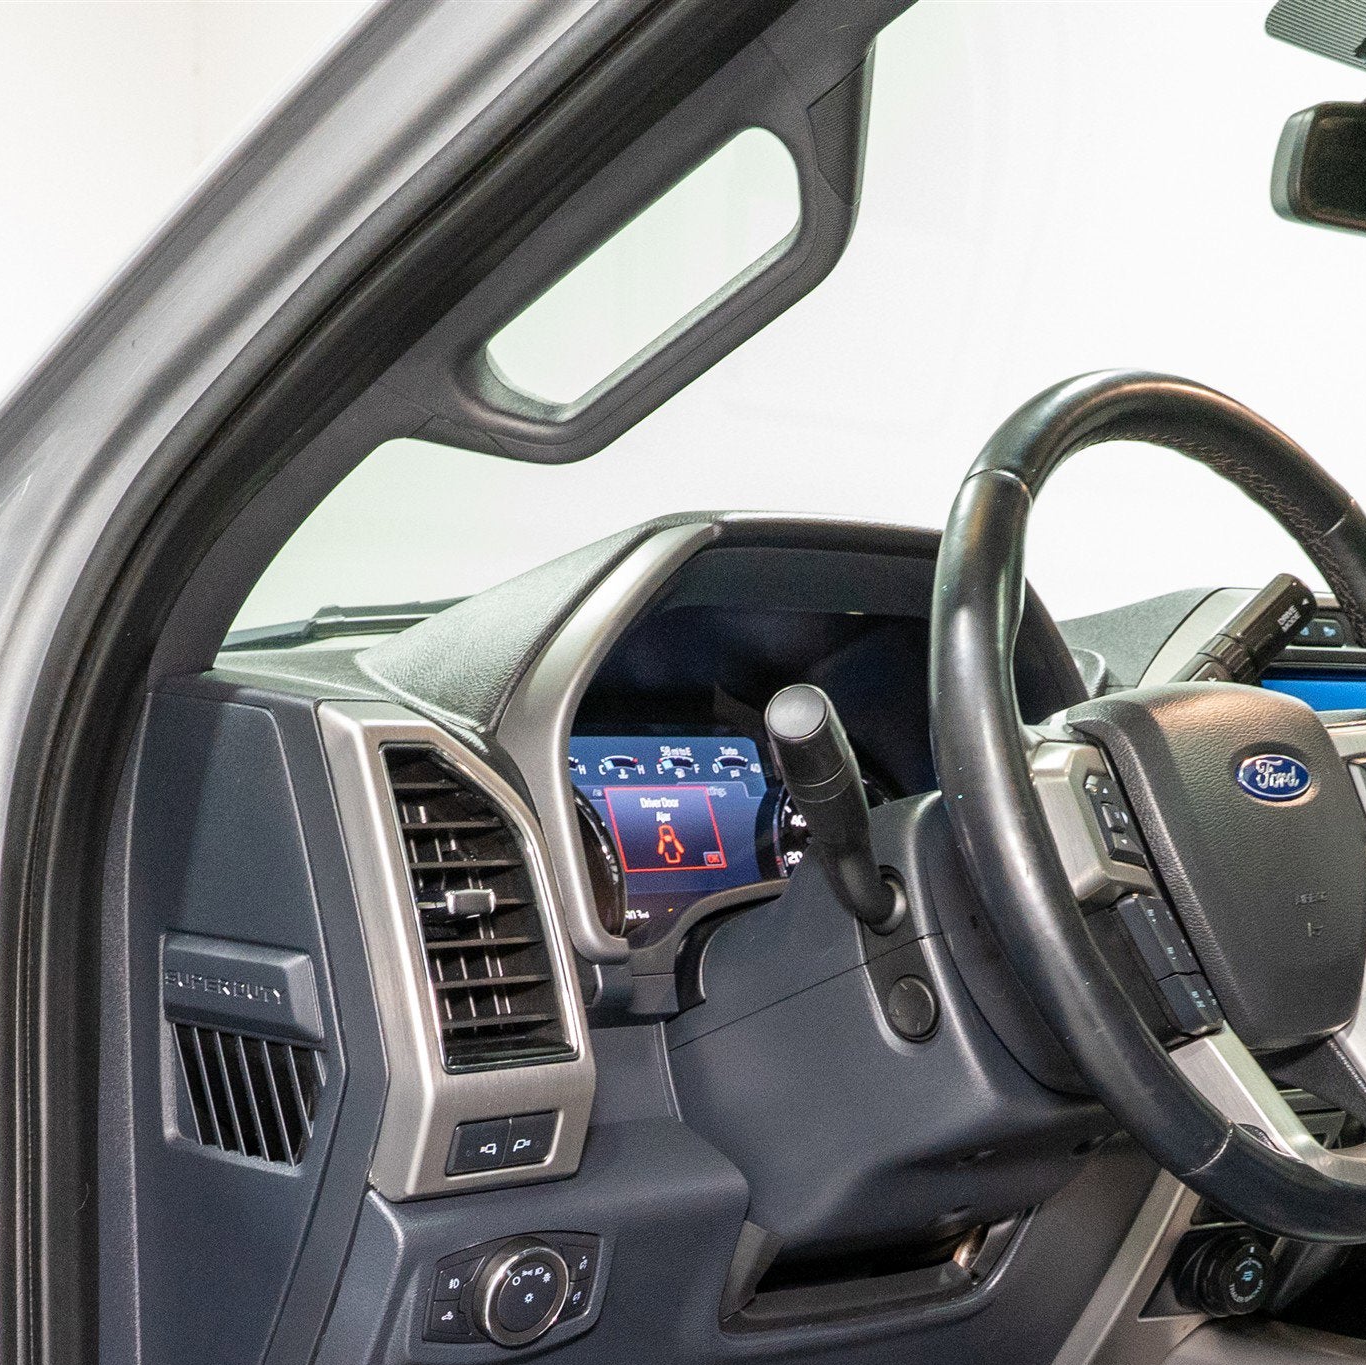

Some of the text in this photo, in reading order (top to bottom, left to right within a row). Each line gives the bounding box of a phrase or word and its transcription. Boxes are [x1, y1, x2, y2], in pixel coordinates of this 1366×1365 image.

[1256, 759, 1300, 789] Ford
[639, 797, 661, 808] Driver
[164, 969, 286, 1005] SUPER DUTY
